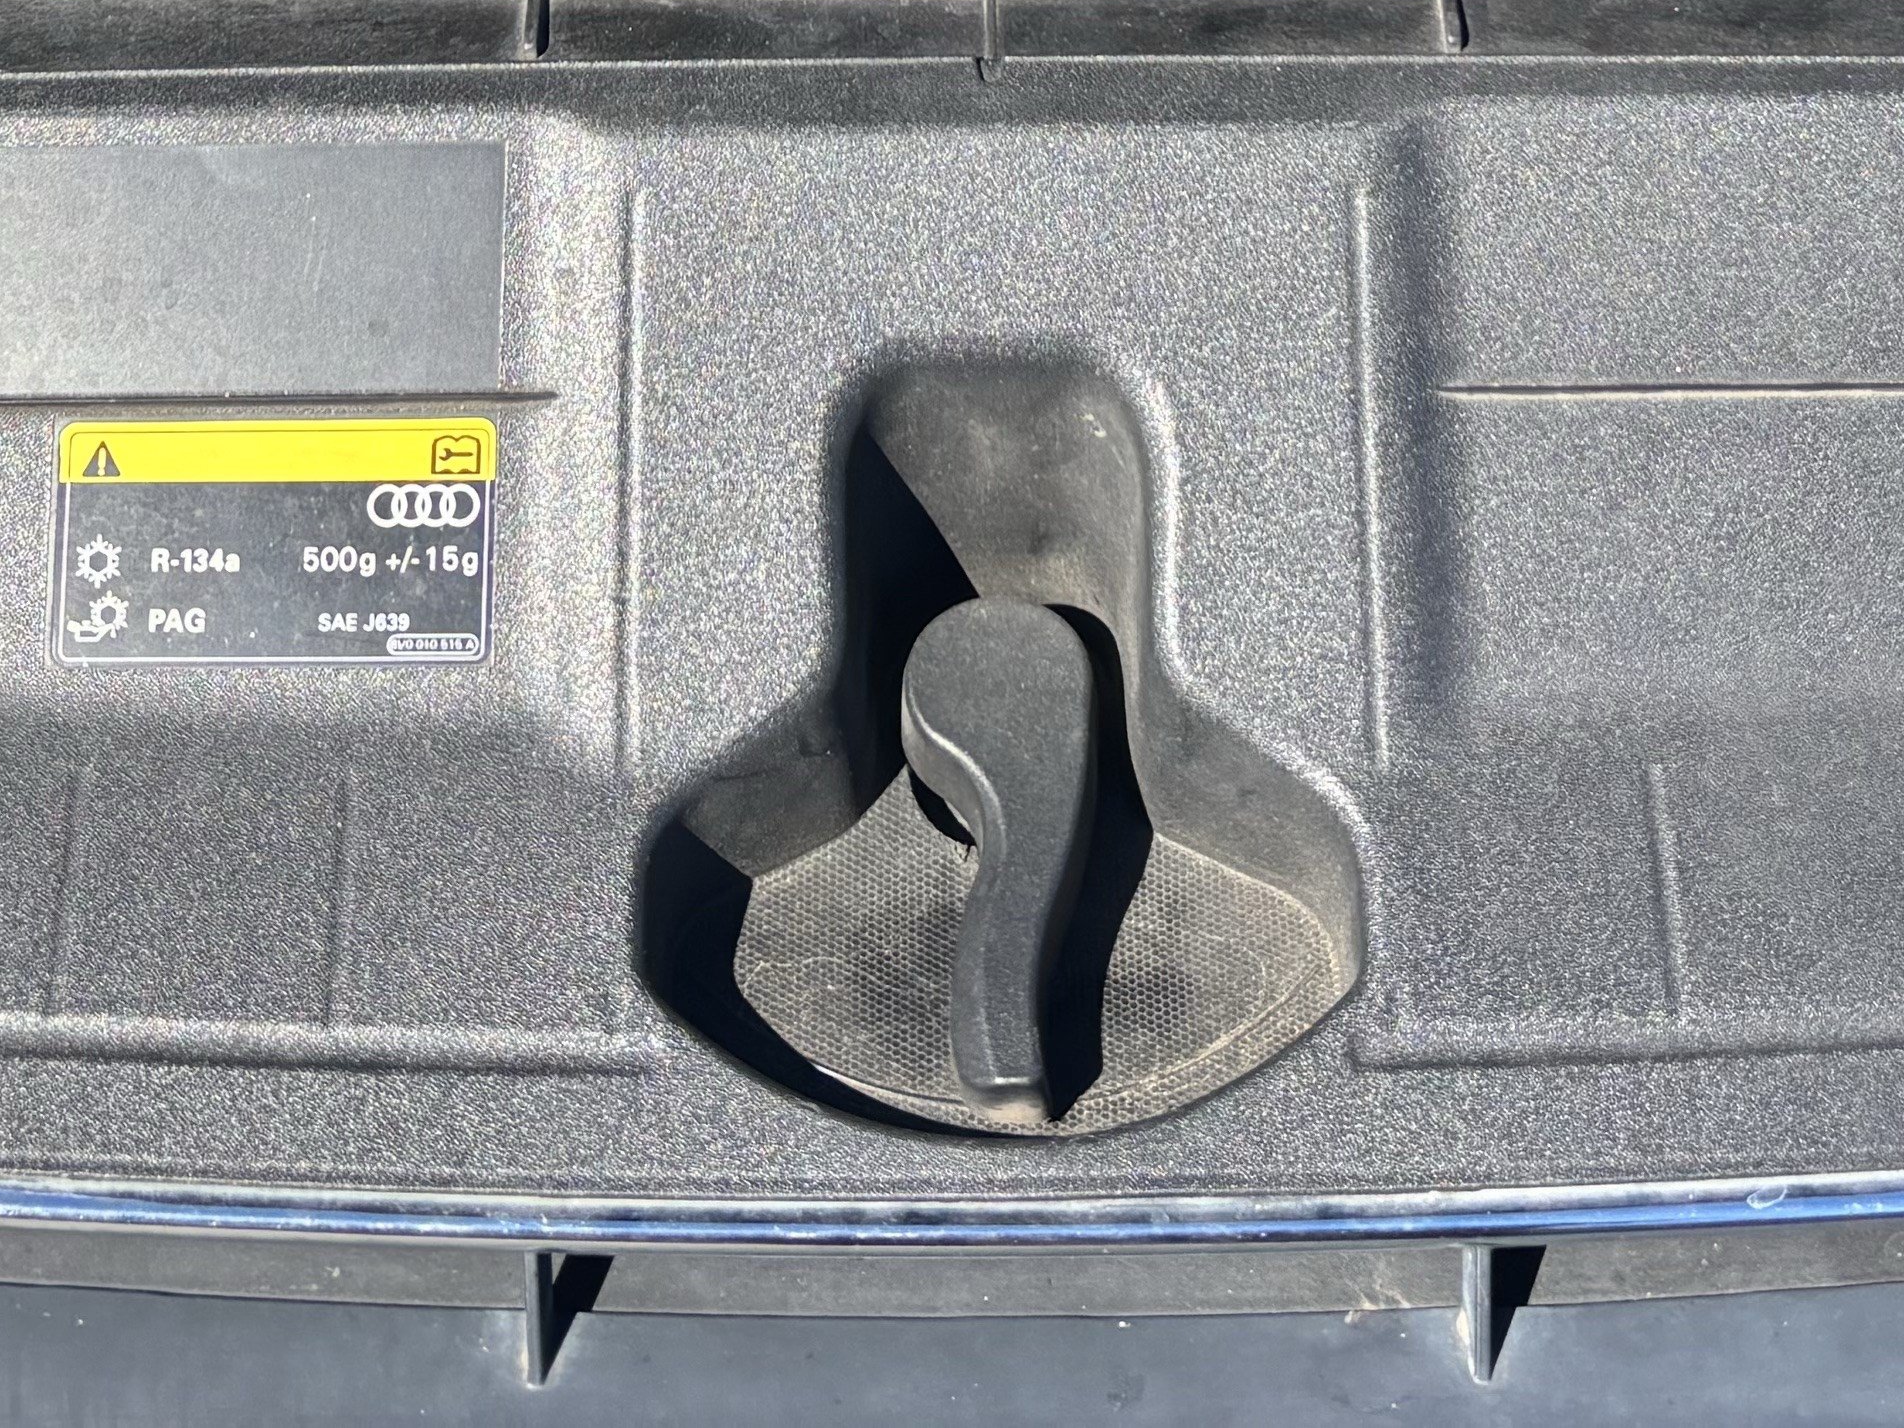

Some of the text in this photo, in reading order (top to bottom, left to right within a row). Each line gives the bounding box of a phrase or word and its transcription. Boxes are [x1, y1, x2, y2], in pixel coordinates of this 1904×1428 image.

[150, 547, 241, 573] R-134a
[302, 545, 377, 578] 500g
[148, 607, 207, 634] PAG
[317, 612, 411, 633] SAE J639
